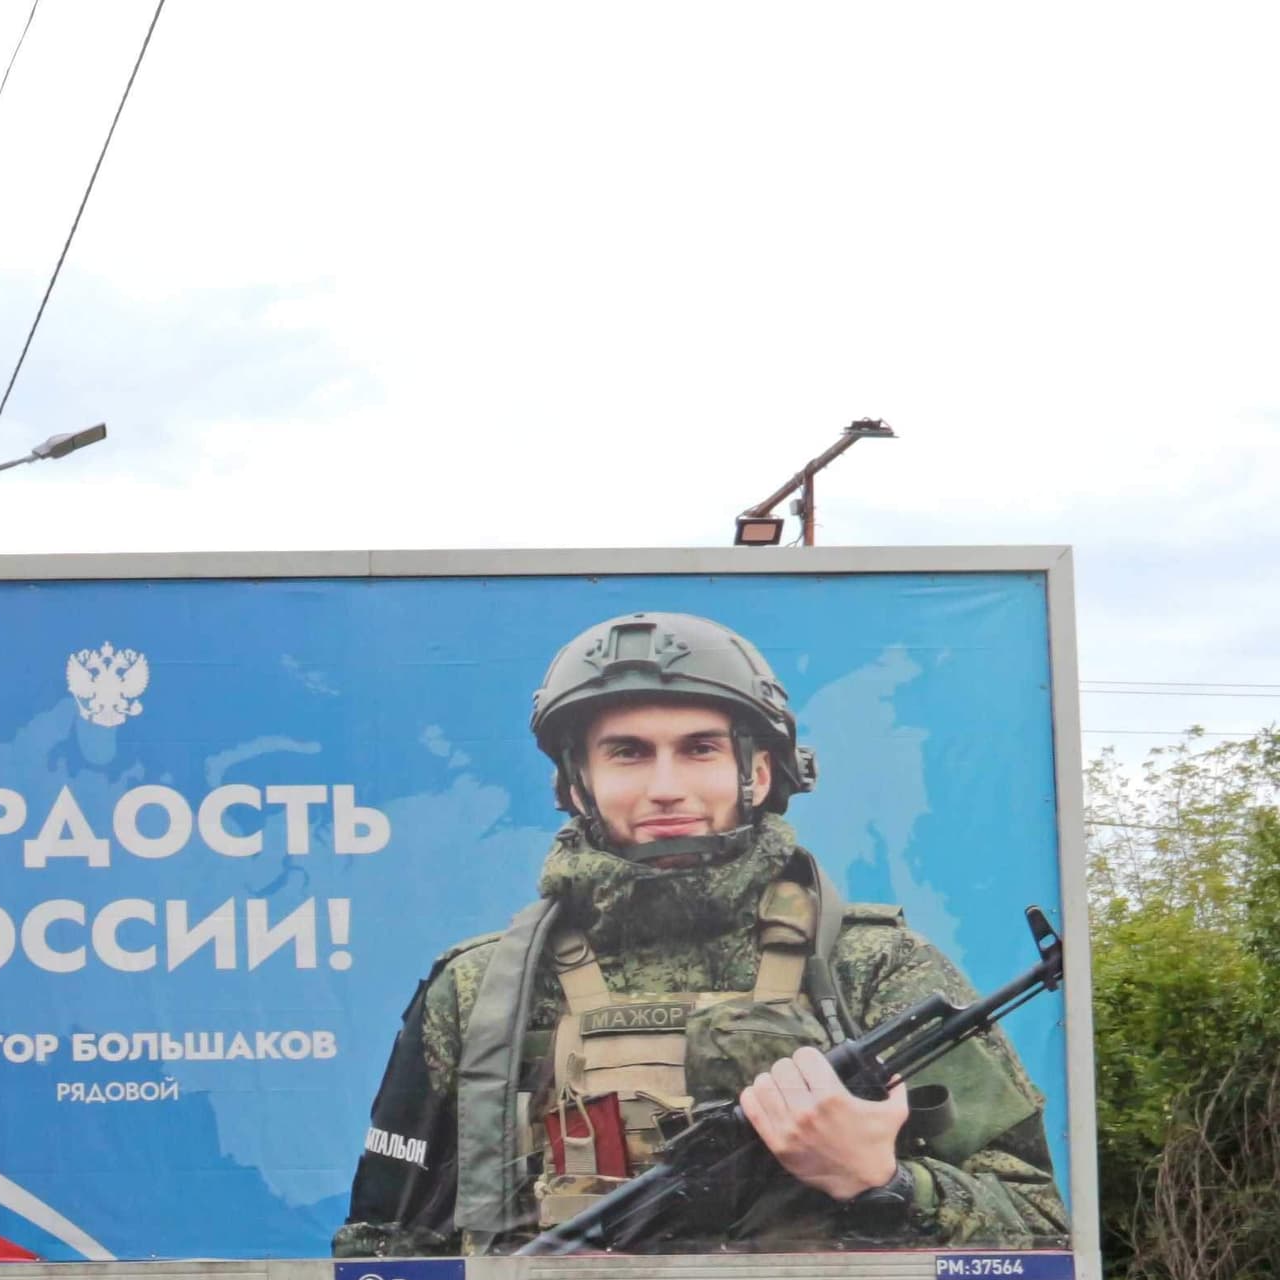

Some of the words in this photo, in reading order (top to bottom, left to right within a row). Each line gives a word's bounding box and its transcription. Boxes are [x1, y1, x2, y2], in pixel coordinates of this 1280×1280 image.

[591, 1007, 683, 1029] МАЖОР
[72, 1030, 337, 1062] БОЛЬШАКОВ
[56, 1077, 179, 1105] РЯДОВОЙ
